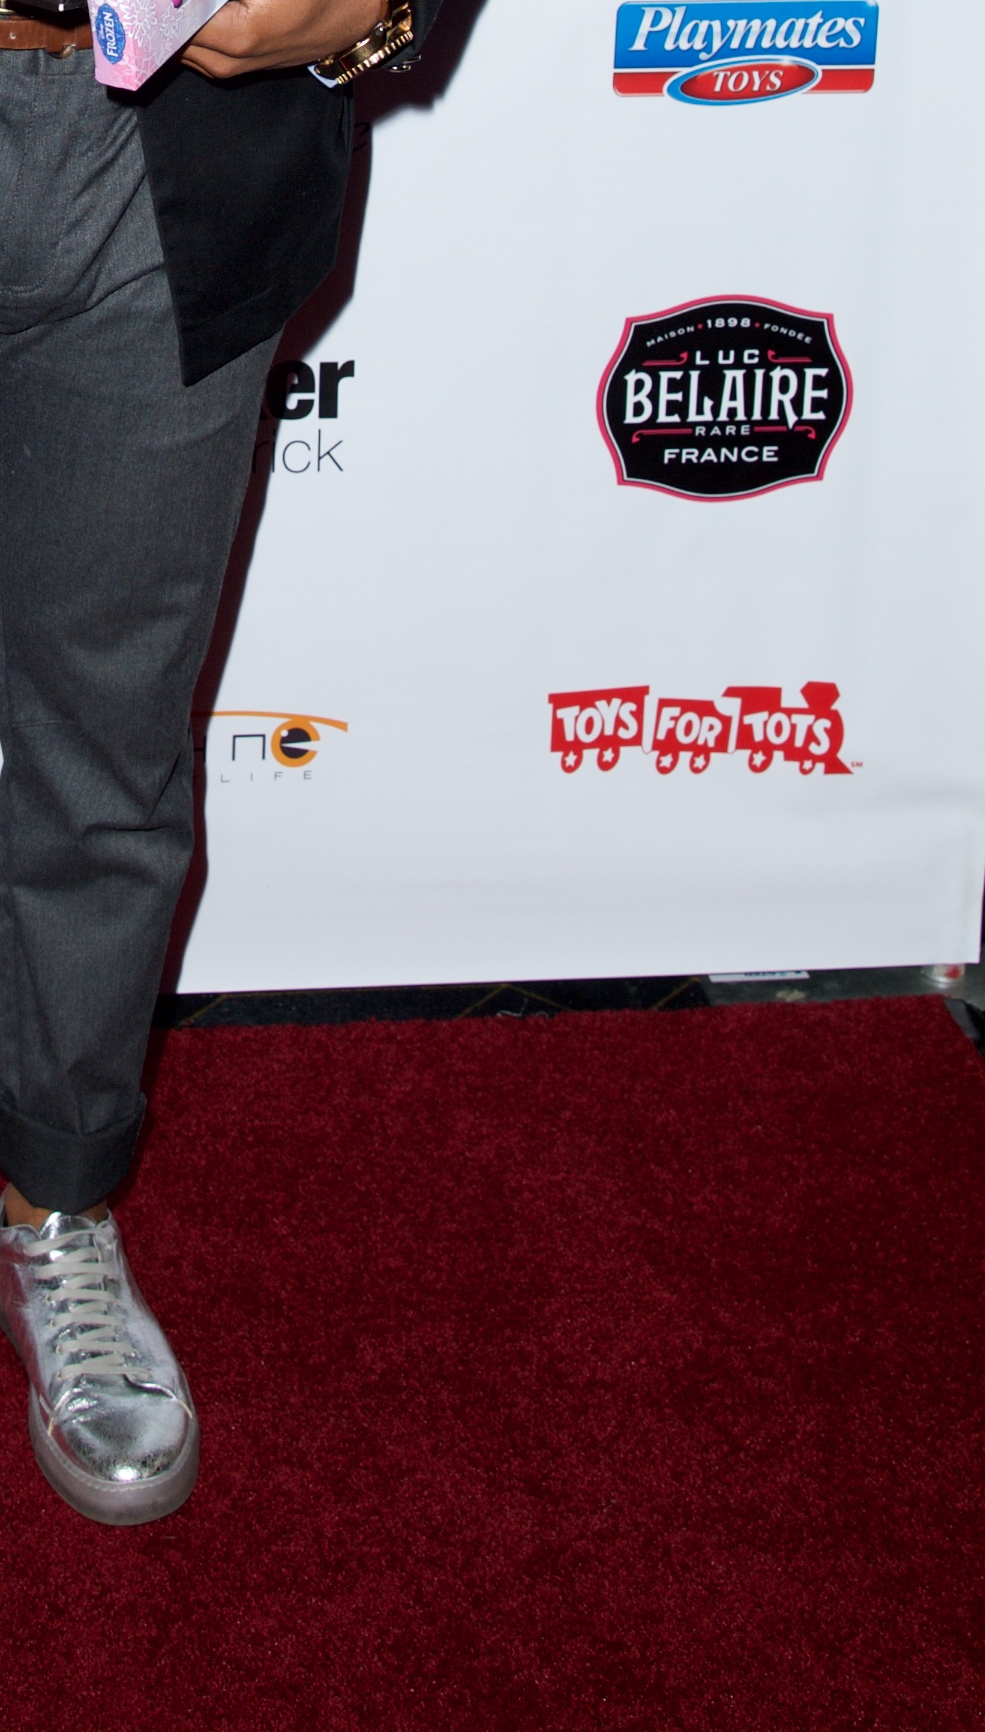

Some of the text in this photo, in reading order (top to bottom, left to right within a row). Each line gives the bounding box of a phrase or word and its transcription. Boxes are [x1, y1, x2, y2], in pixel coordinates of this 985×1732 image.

[103, 11, 119, 57] FROZEN
[628, 5, 865, 61] Playmates
[713, 69, 784, 93] TOYS
[646, 326, 694, 347] MAISON
[707, 318, 751, 328] 1898
[695, 349, 760, 365] LUC
[261, 360, 355, 420] er
[623, 366, 829, 430] BELAIRE
[696, 425, 750, 436] RARE
[663, 446, 779, 464] FRANCE
[556, 698, 833, 756] TOYS FOR TOTS
